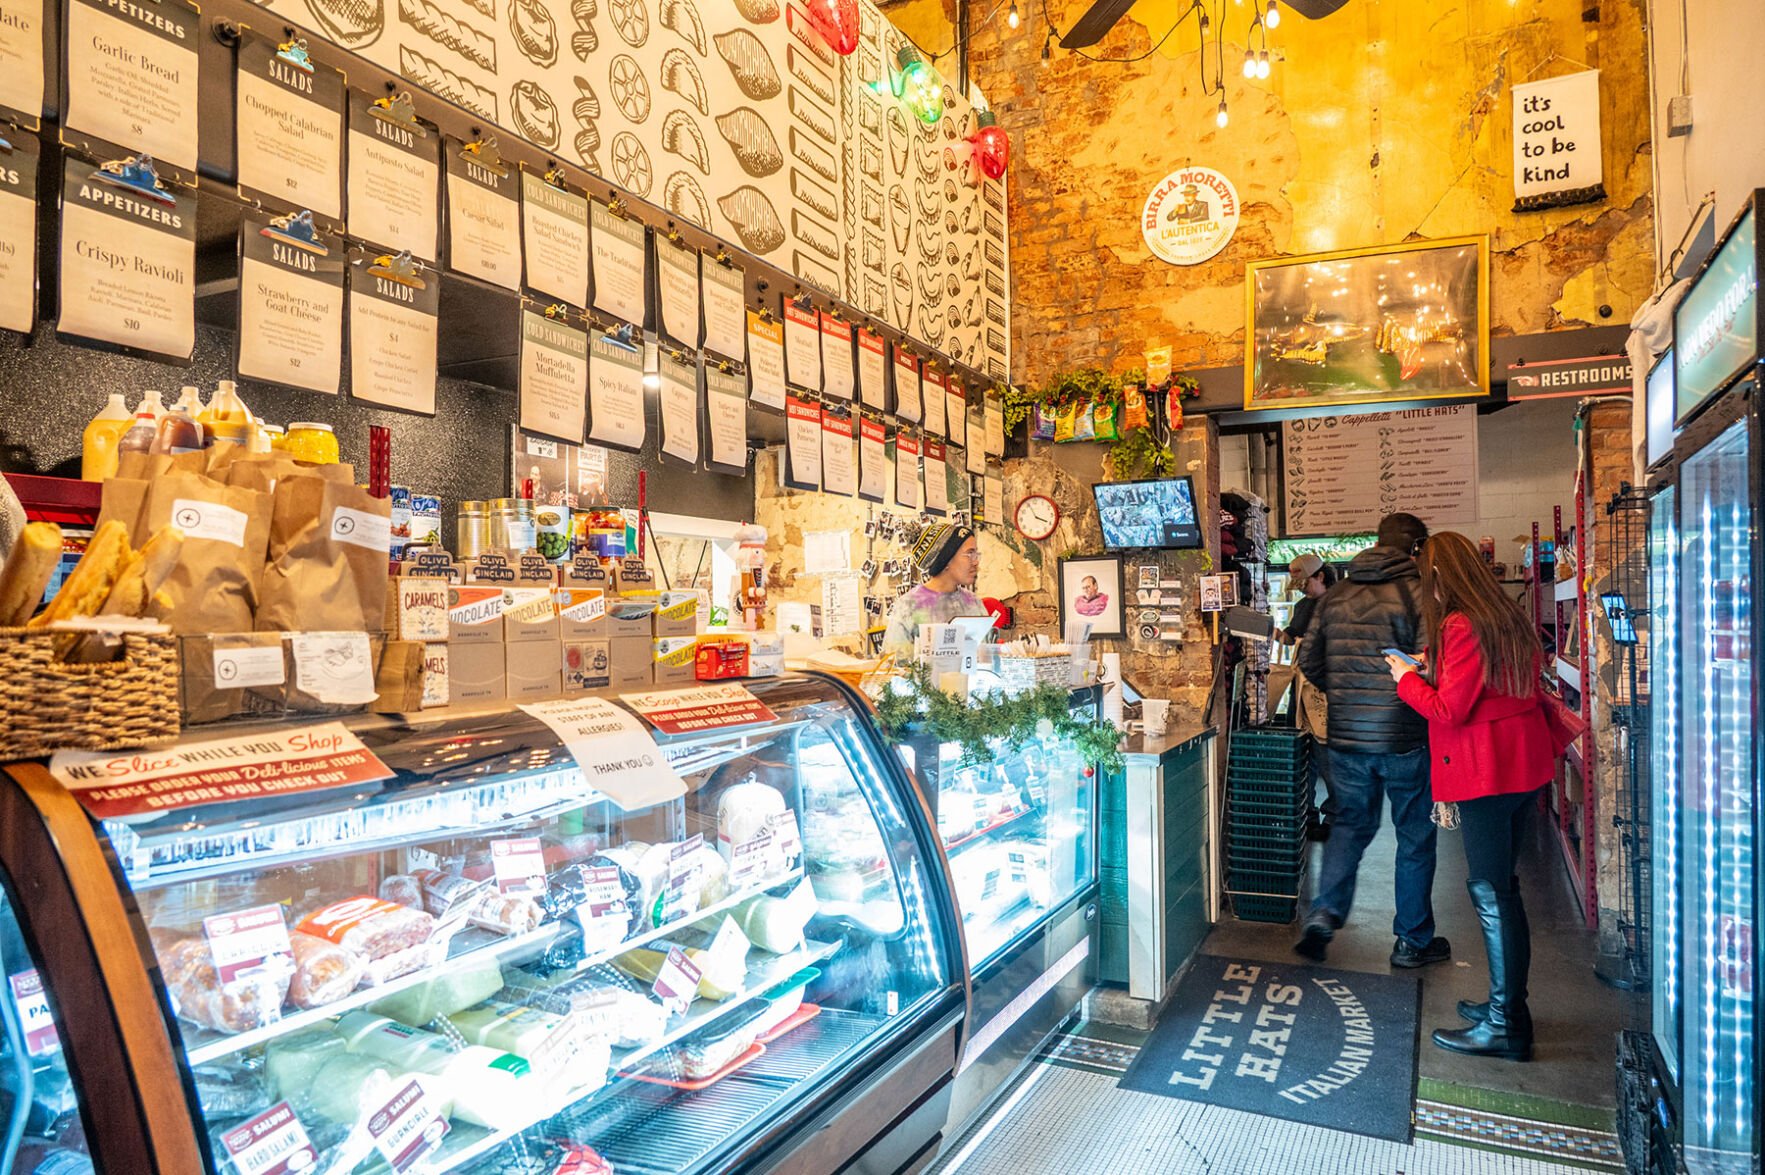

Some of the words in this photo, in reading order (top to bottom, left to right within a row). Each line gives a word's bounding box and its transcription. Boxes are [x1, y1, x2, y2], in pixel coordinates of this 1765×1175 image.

[91, 32, 136, 67] Garlic
[140, 53, 179, 85] Bread
[269, 60, 313, 94] SALADS
[244, 91, 288, 125] Chopped
[289, 111, 334, 142] Calabrian
[1523, 95, 1551, 114] it's
[277, 119, 304, 140] Salad
[375, 119, 414, 149] SALADS
[1522, 115, 1565, 134] cool
[1521, 141, 1545, 158] to
[1552, 137, 1577, 154] be
[365, 146, 403, 173] Antipasto
[403, 161, 425, 179] Salad
[1523, 162, 1570, 184] kind
[467, 162, 499, 189] SALADS
[79, 184, 183, 229] APPETIZERS
[544, 189, 585, 221] SANDWICHES
[1146, 179, 1178, 231] BIRRA
[1180, 171, 1235, 218] MORETTI
[1161, 221, 1220, 240] L'AUTENTICA
[74, 237, 129, 274] Crispy
[132, 254, 184, 285] Ravioli
[273, 243, 316, 272] SALADS
[256, 281, 310, 312] Strawberry
[311, 298, 329, 314] and
[376, 277, 414, 303] SALADS
[264, 296, 287, 314] Goat
[289, 303, 322, 324] Cheese
[122, 316, 140, 332] $10
[526, 320, 544, 340] COLD
[544, 326, 585, 354] SANDWICHES
[535, 350, 576, 374] Mortadella
[535, 361, 575, 385] Muffuletta
[598, 374, 617, 393] Spicy
[617, 379, 637, 397] Italian
[1540, 364, 1634, 388] RESTROOMS
[420, 556, 448, 565] OLIVE
[481, 556, 505, 565] OLIVE
[522, 556, 544, 565] OLIVE
[576, 559, 597, 567] OLIVE
[625, 560, 643, 569] OLIVE
[412, 570, 455, 578] SINCLAIR
[475, 569, 514, 579] SINCLAIR
[520, 569, 551, 578] SINCLAIR
[572, 570, 604, 579] SINCLAIR
[404, 591, 445, 611] CARAMELS
[450, 599, 502, 624] HOCOLATE
[508, 598, 553, 623] HOCOLATE
[425, 657, 446, 675] MELS
[644, 695, 681, 709] Scoop
[681, 693, 704, 703] WHILE
[704, 690, 722, 700] YOU
[721, 686, 748, 700] Shop
[557, 713, 587, 724] STAFF
[588, 713, 598, 722] OF
[599, 710, 617, 720] ANY
[652, 712, 675, 723] PLEASE
[675, 710, 693, 720] ORDER
[693, 707, 709, 718] YOUR
[677, 719, 705, 730] BEFORE
[705, 717, 721, 727] YOU
[721, 715, 743, 726] CHECK
[743, 713, 758, 723] OUT
[577, 721, 625, 737] ALLERGIES!
[64, 763, 105, 782] WE
[106, 755, 181, 778] Slice
[180, 744, 243, 765] WHILE
[245, 741, 283, 756] YOU
[288, 732, 344, 754] Shop
[593, 761, 624, 776] THANK
[626, 758, 643, 769] YOU
[89, 782, 149, 803] PLEASE
[149, 775, 198, 794] ORDER
[198, 769, 242, 787] YOUR
[241, 757, 329, 780] Deli-licious
[328, 752, 368, 768] ITEMS
[146, 787, 225, 809] BEFORE
[225, 780, 262, 798] YOU
[262, 775, 318, 793] CHECK
[319, 770, 349, 786] OUT
[1311, 977, 1375, 1045] MARKET
[1168, 963, 1262, 1091] LITTLE
[1234, 982, 1304, 1084] HATS
[1278, 1047, 1374, 1105] ITALIAN
[388, 1085, 421, 1116] SALUMI
[252, 1106, 291, 1136] SALUMI
[387, 1106, 430, 1149] GUANCIALE
[269, 1130, 299, 1155] SALAMI
